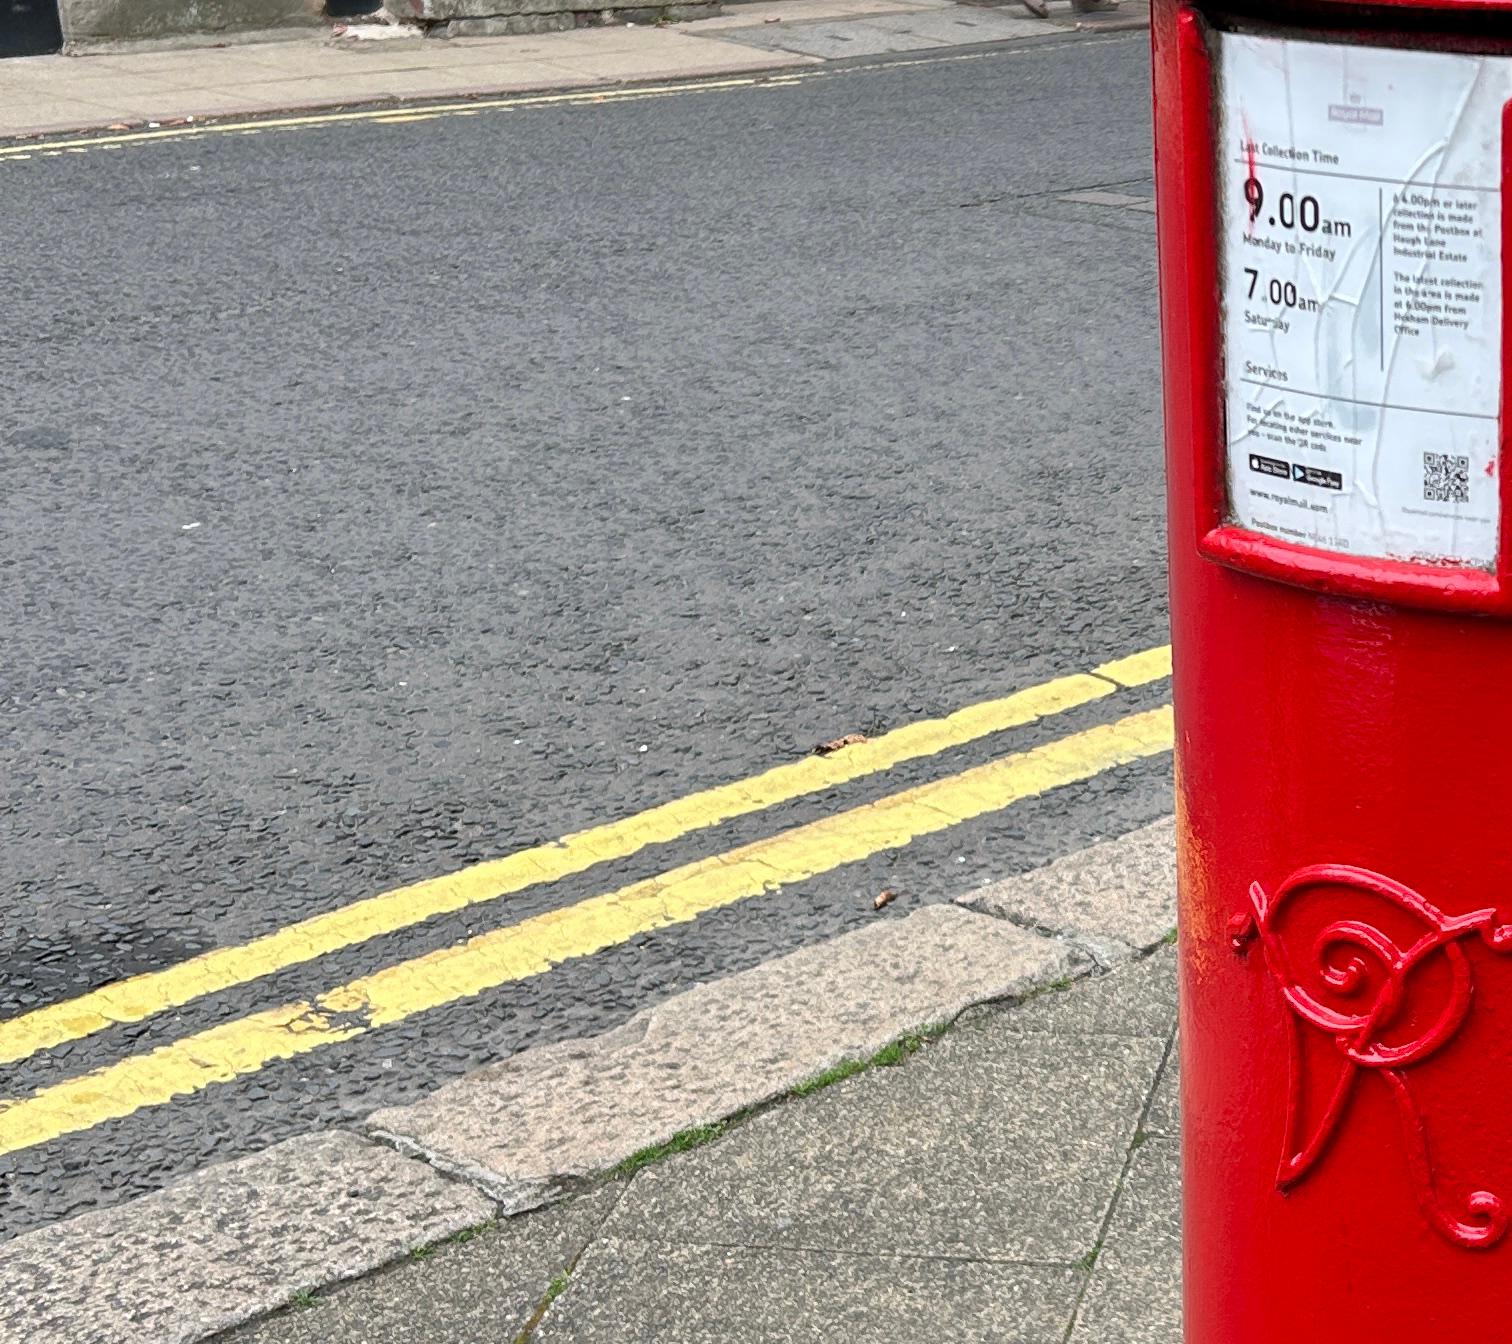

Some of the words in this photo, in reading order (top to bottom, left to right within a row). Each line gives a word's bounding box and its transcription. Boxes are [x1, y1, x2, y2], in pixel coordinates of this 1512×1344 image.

[1240, 139, 1259, 154] Last
[1262, 143, 1309, 161] Collection
[1312, 149, 1340, 165] Time
[1243, 232, 1281, 253] Monday
[1285, 242, 1296, 254] to
[1299, 243, 1336, 262] Friday
[1244, 310, 1290, 334] Saturday
[1245, 360, 1288, 382] Services
